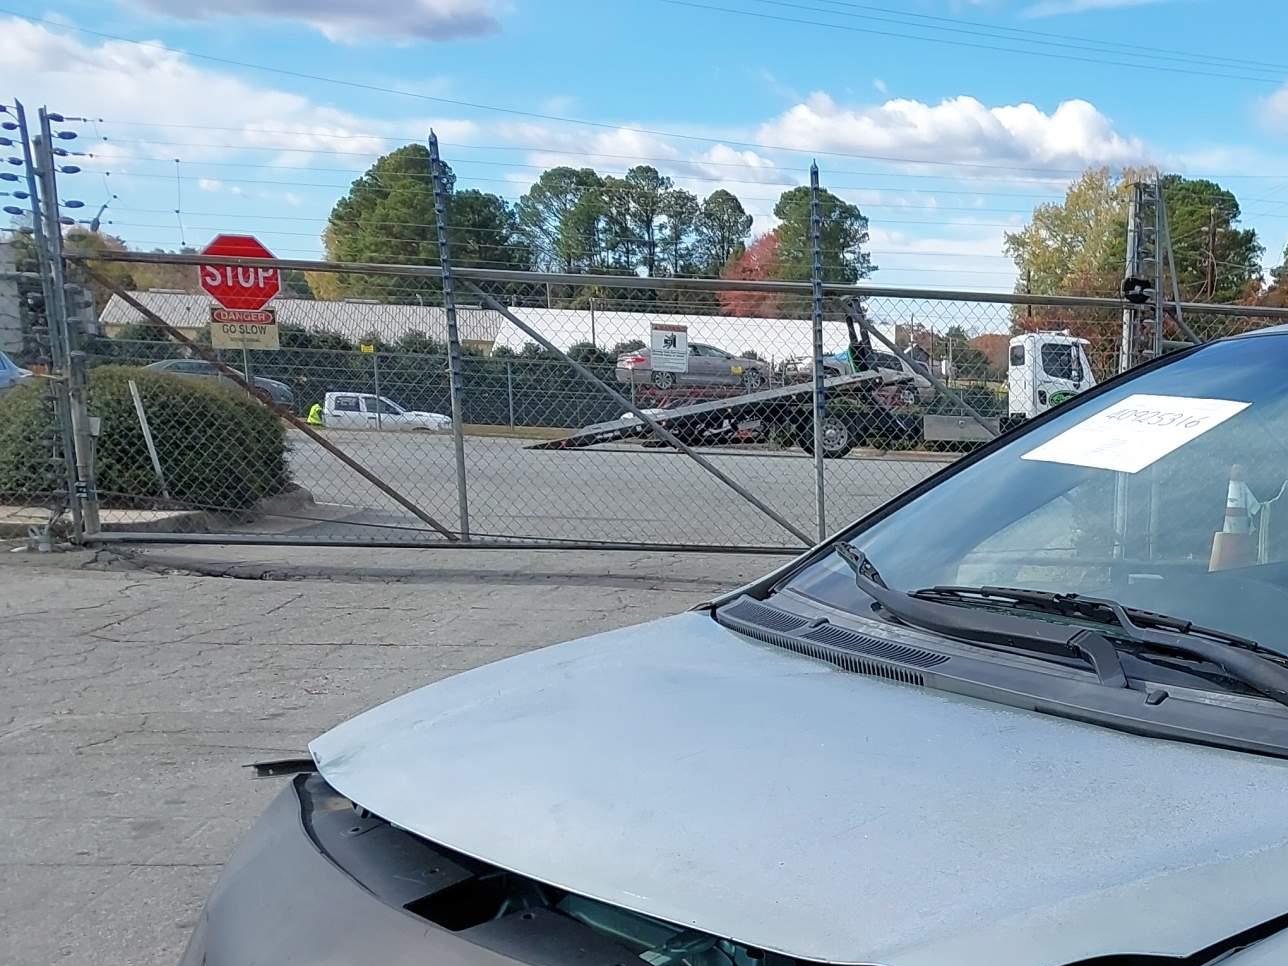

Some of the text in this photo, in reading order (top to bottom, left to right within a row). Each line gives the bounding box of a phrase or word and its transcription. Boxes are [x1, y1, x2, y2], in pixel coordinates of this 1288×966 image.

[205, 265, 273, 288] STOP
[220, 311, 265, 321] DANGER
[222, 324, 266, 335] GO SLOW
[1106, 407, 1210, 429] 40925316
